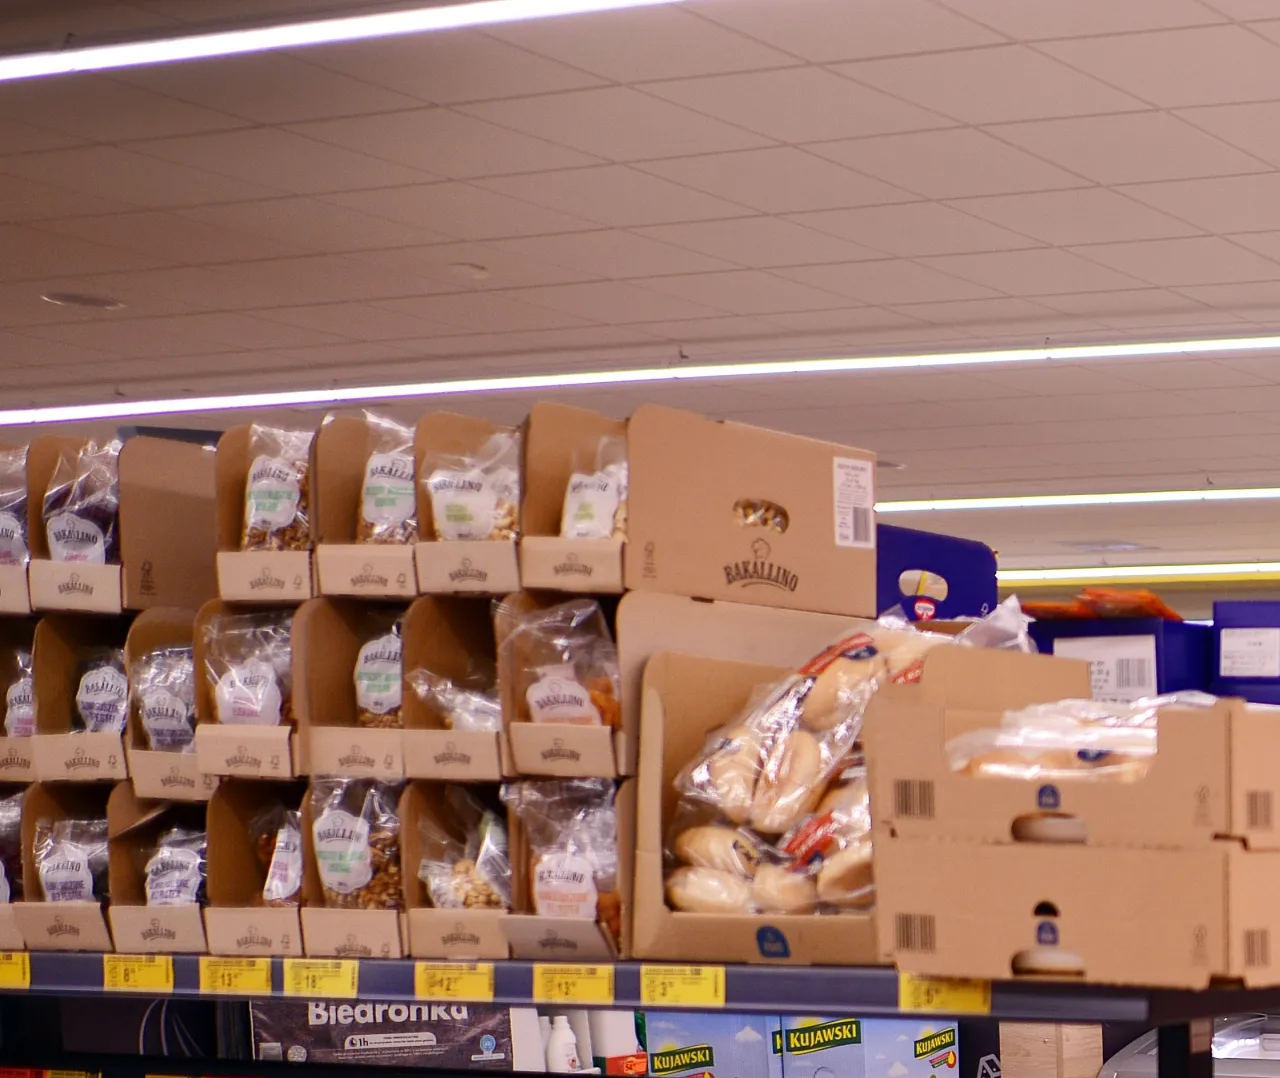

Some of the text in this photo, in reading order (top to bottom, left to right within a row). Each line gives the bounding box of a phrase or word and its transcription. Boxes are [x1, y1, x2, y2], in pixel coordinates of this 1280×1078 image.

[723, 560, 799, 592] BAKALLINO
[789, 1020, 859, 1049] KUJAWSKI
[916, 1030, 955, 1056] KUJAWSKI
[653, 1046, 712, 1072] KUJAWSKI
